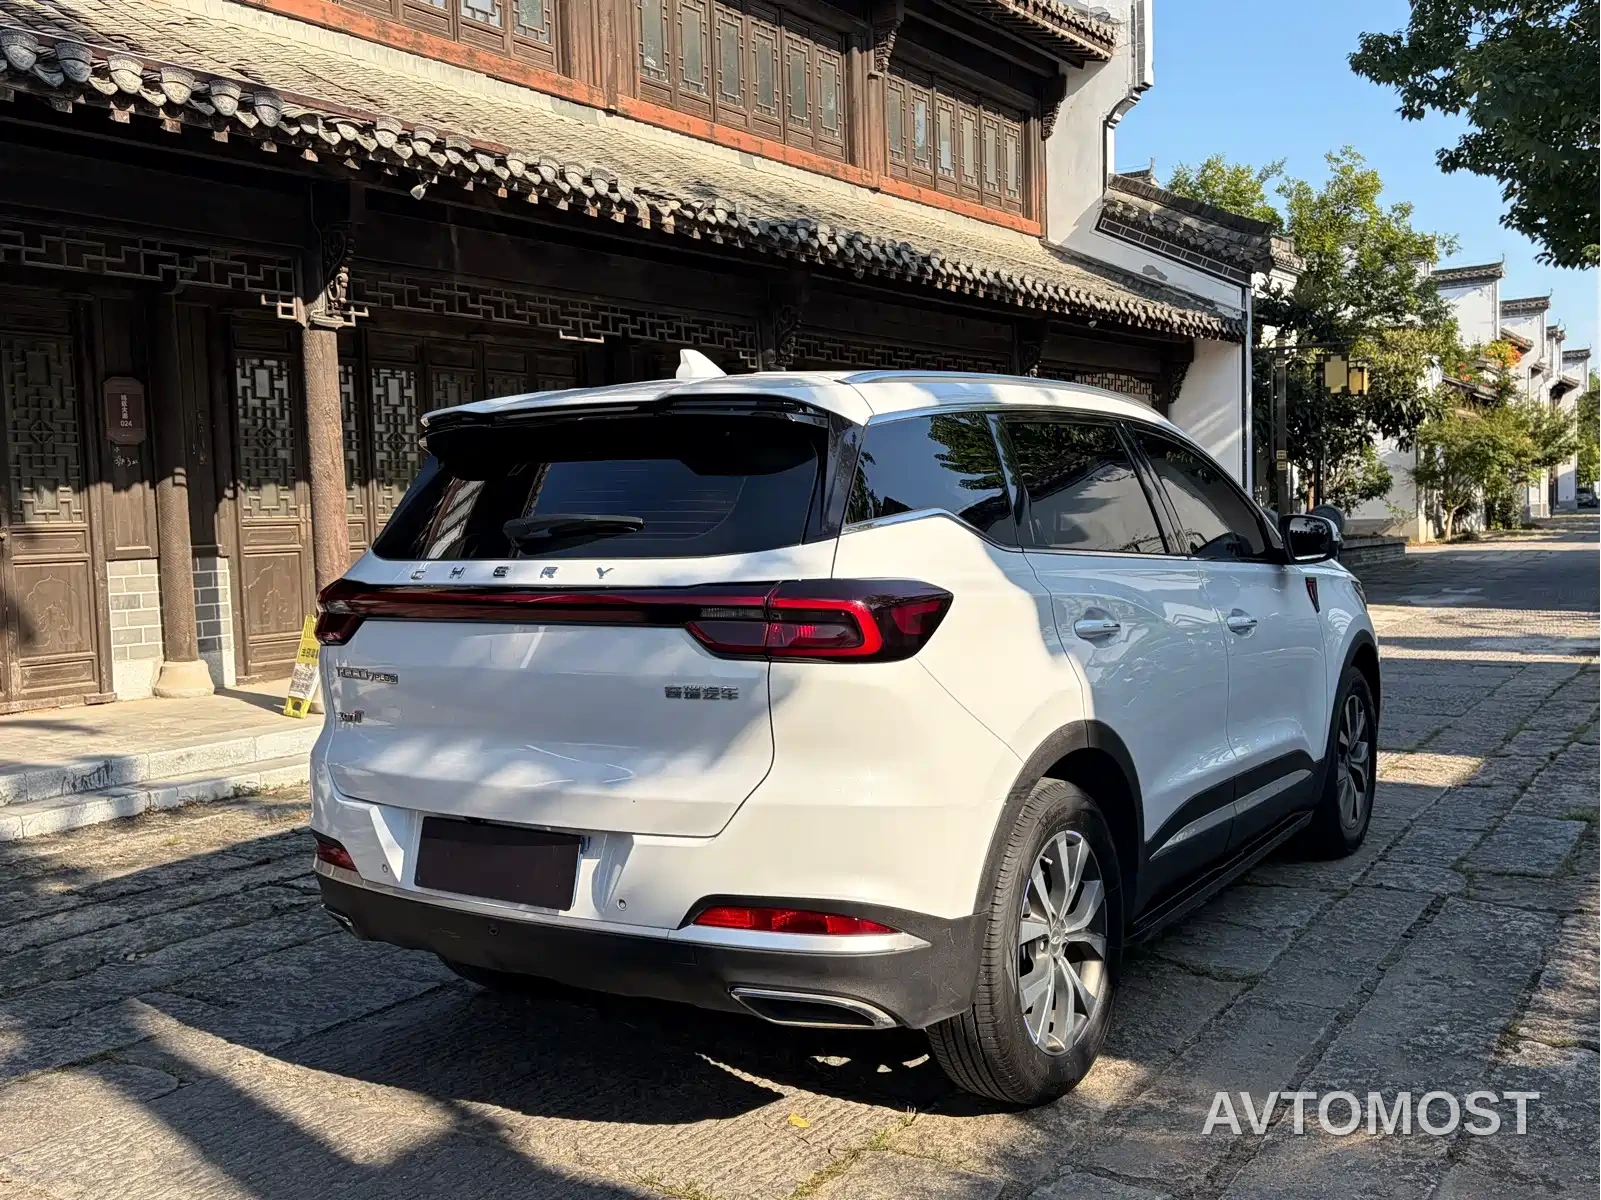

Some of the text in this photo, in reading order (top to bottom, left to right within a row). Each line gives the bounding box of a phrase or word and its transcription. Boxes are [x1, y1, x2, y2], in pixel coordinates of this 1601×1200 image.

[410, 566, 614, 580] CHERY
[664, 685, 740, 700] 奇瑞汽车
